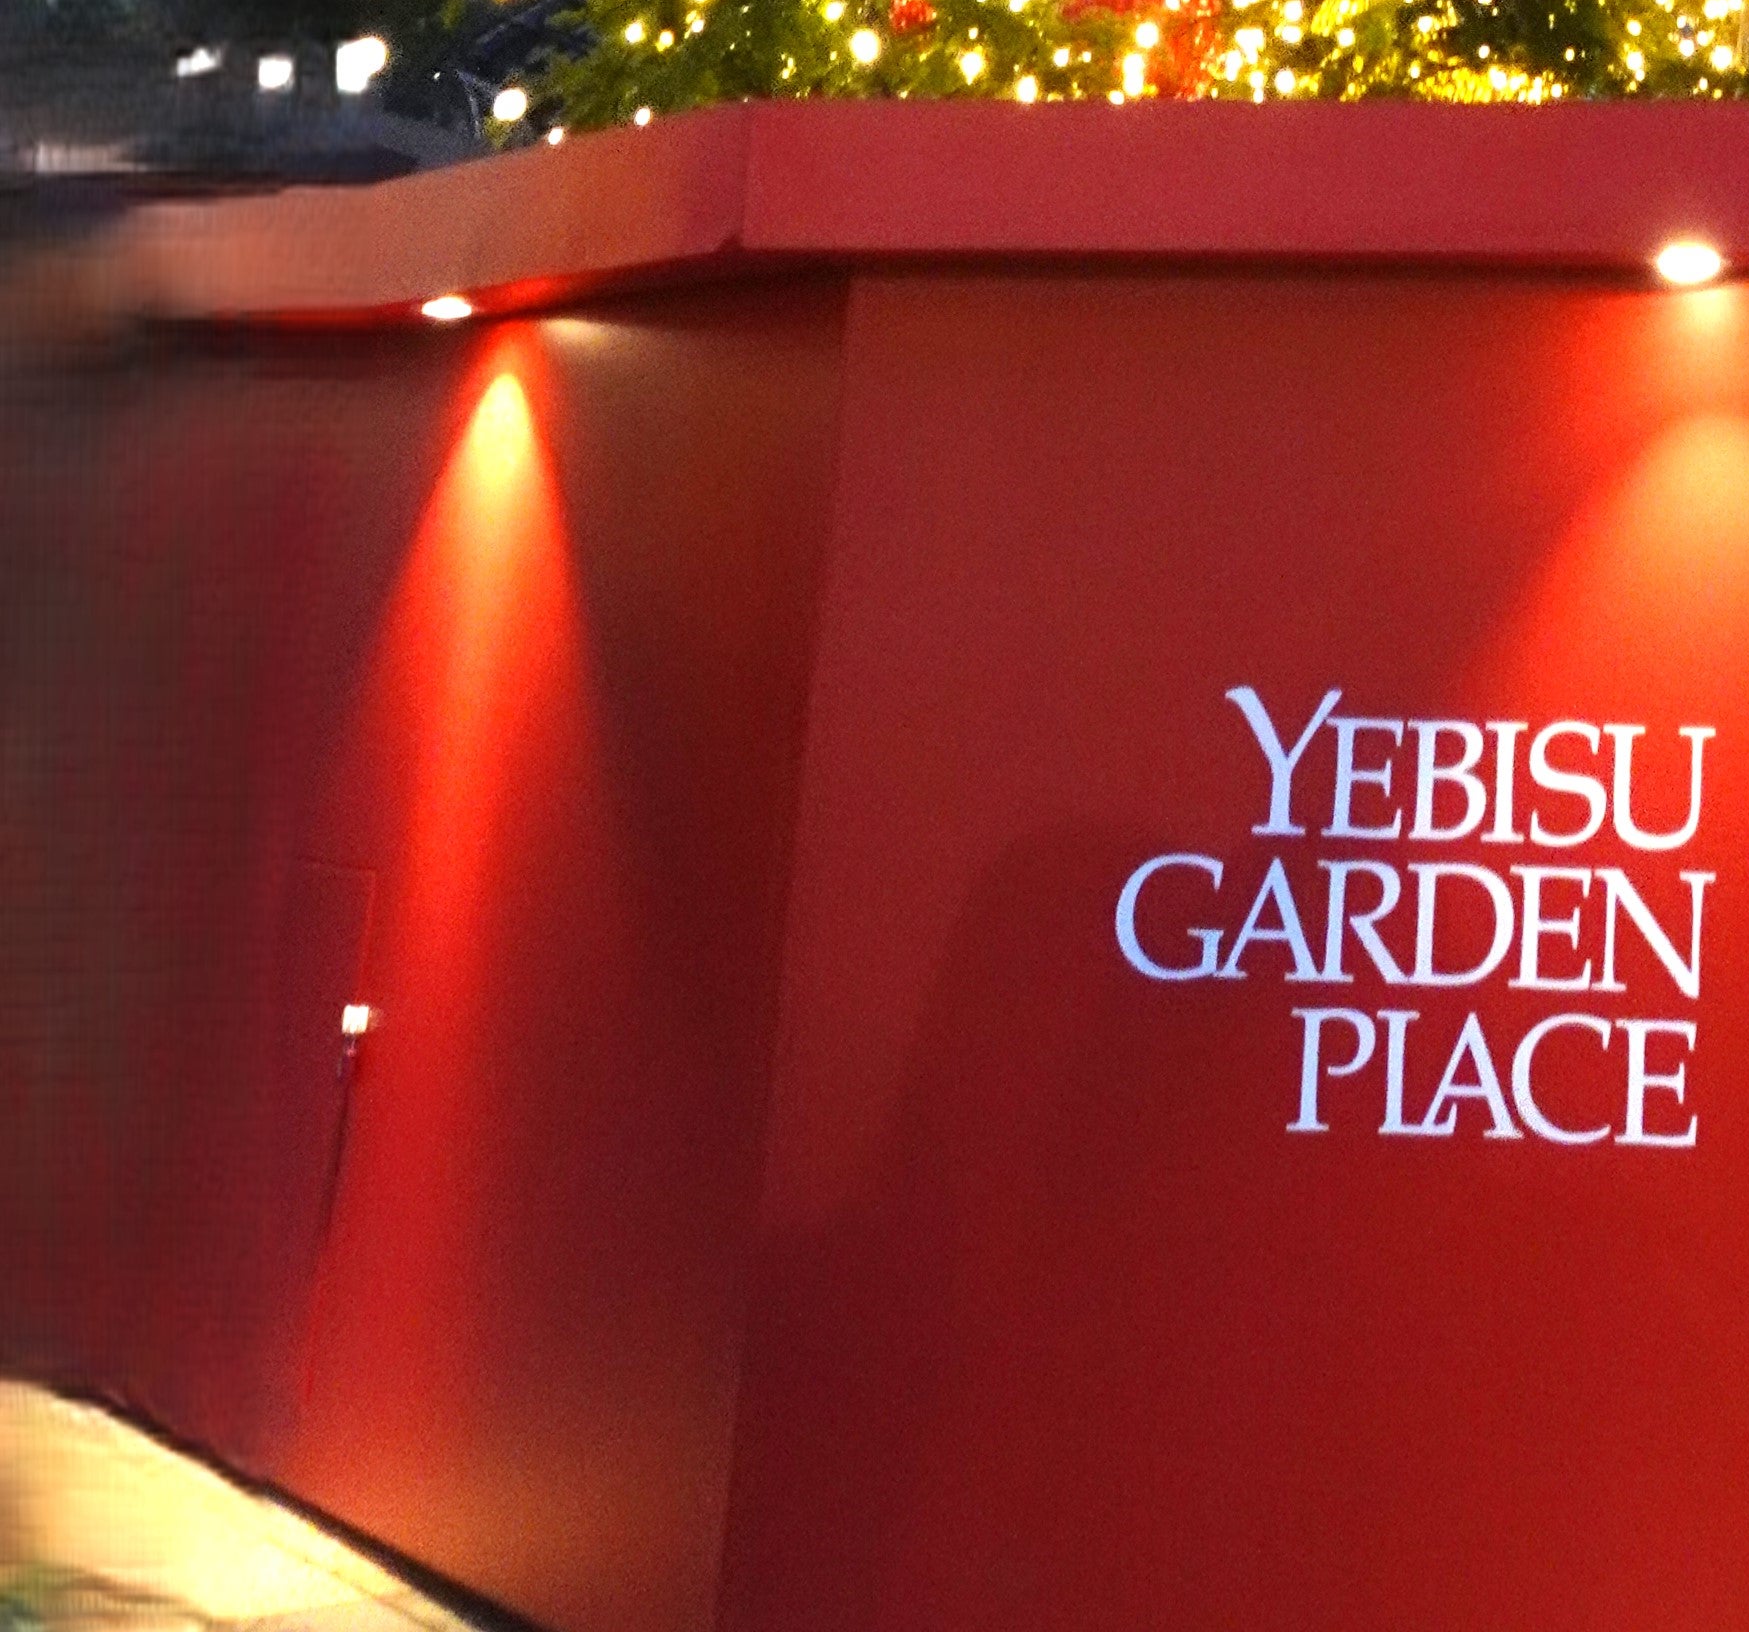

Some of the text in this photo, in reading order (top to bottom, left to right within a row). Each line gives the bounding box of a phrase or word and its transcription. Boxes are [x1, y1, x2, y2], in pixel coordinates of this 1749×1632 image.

[1225, 686, 1718, 852] YEBISU
[1115, 853, 1718, 1001] GARDEN
[1286, 1007, 1699, 1149] PLACE
